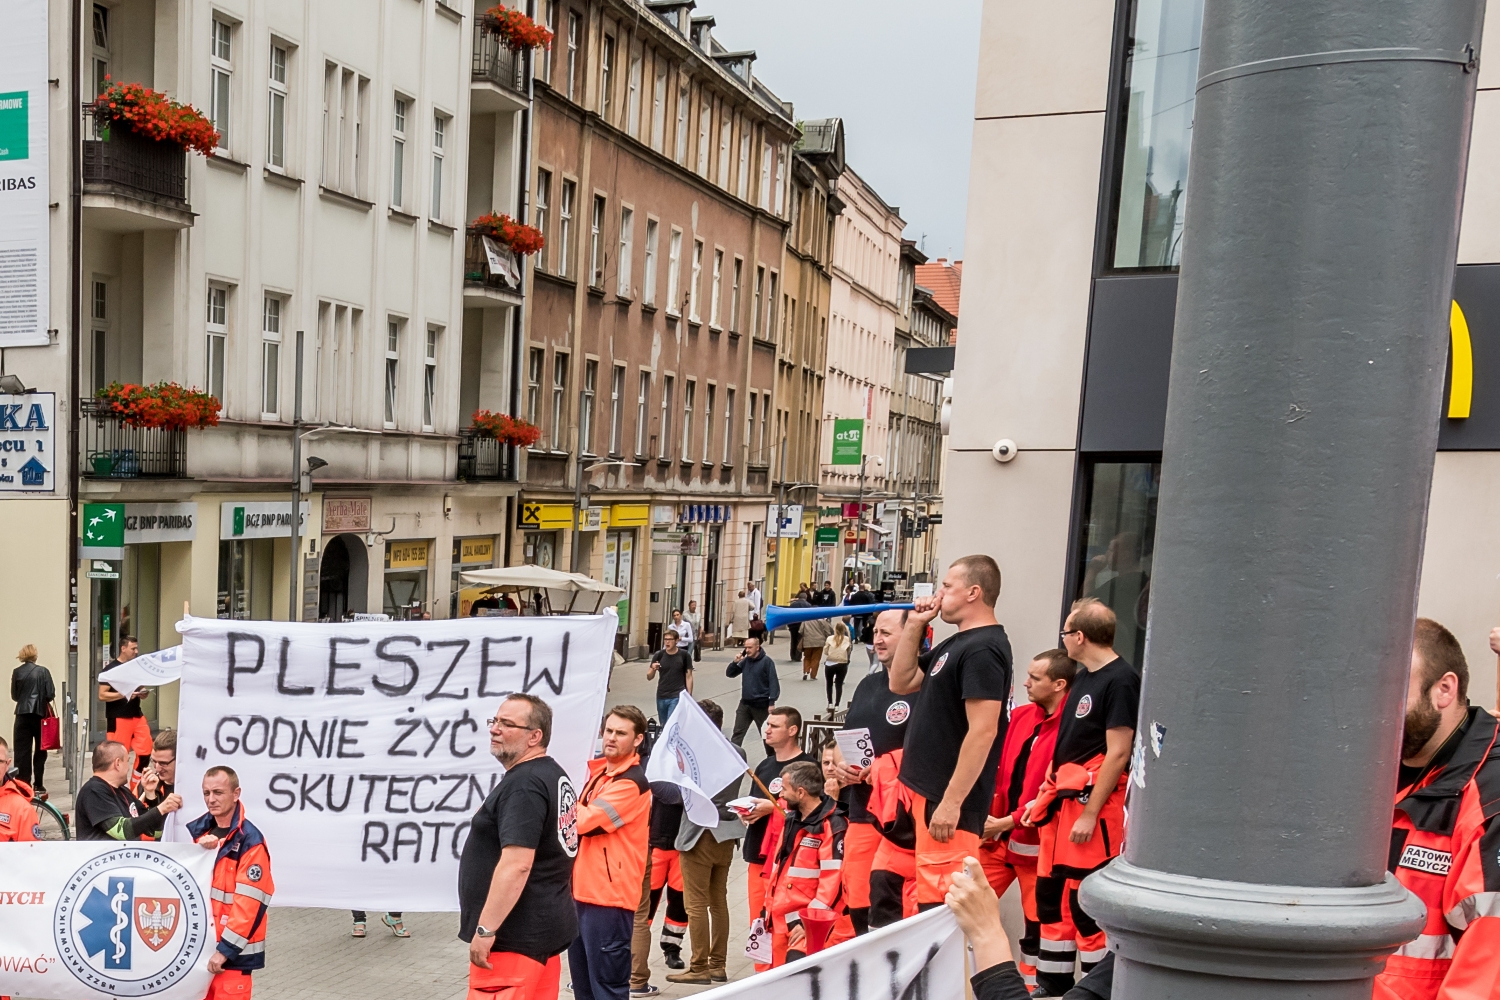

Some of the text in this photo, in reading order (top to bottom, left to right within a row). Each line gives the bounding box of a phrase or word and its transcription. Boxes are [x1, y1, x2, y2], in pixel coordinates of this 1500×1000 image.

[1, 458, 7, 467] 5
[139, 515, 157, 530] BNP
[158, 514, 193, 529] PARIBAS
[261, 513, 276, 526] BNP
[276, 512, 304, 526] PARIS
[226, 630, 571, 698] PLESZEW
[388, 707, 477, 759] ŻYĆ
[265, 772, 504, 814] SKUTECZN
[1406, 847, 1453, 864] RATOWN
[59, 851, 199, 991] NSZZ RATOWNIKÓW MEDYCZNYCH POŁUDNIOWEJ WIELKOPOLSKI
